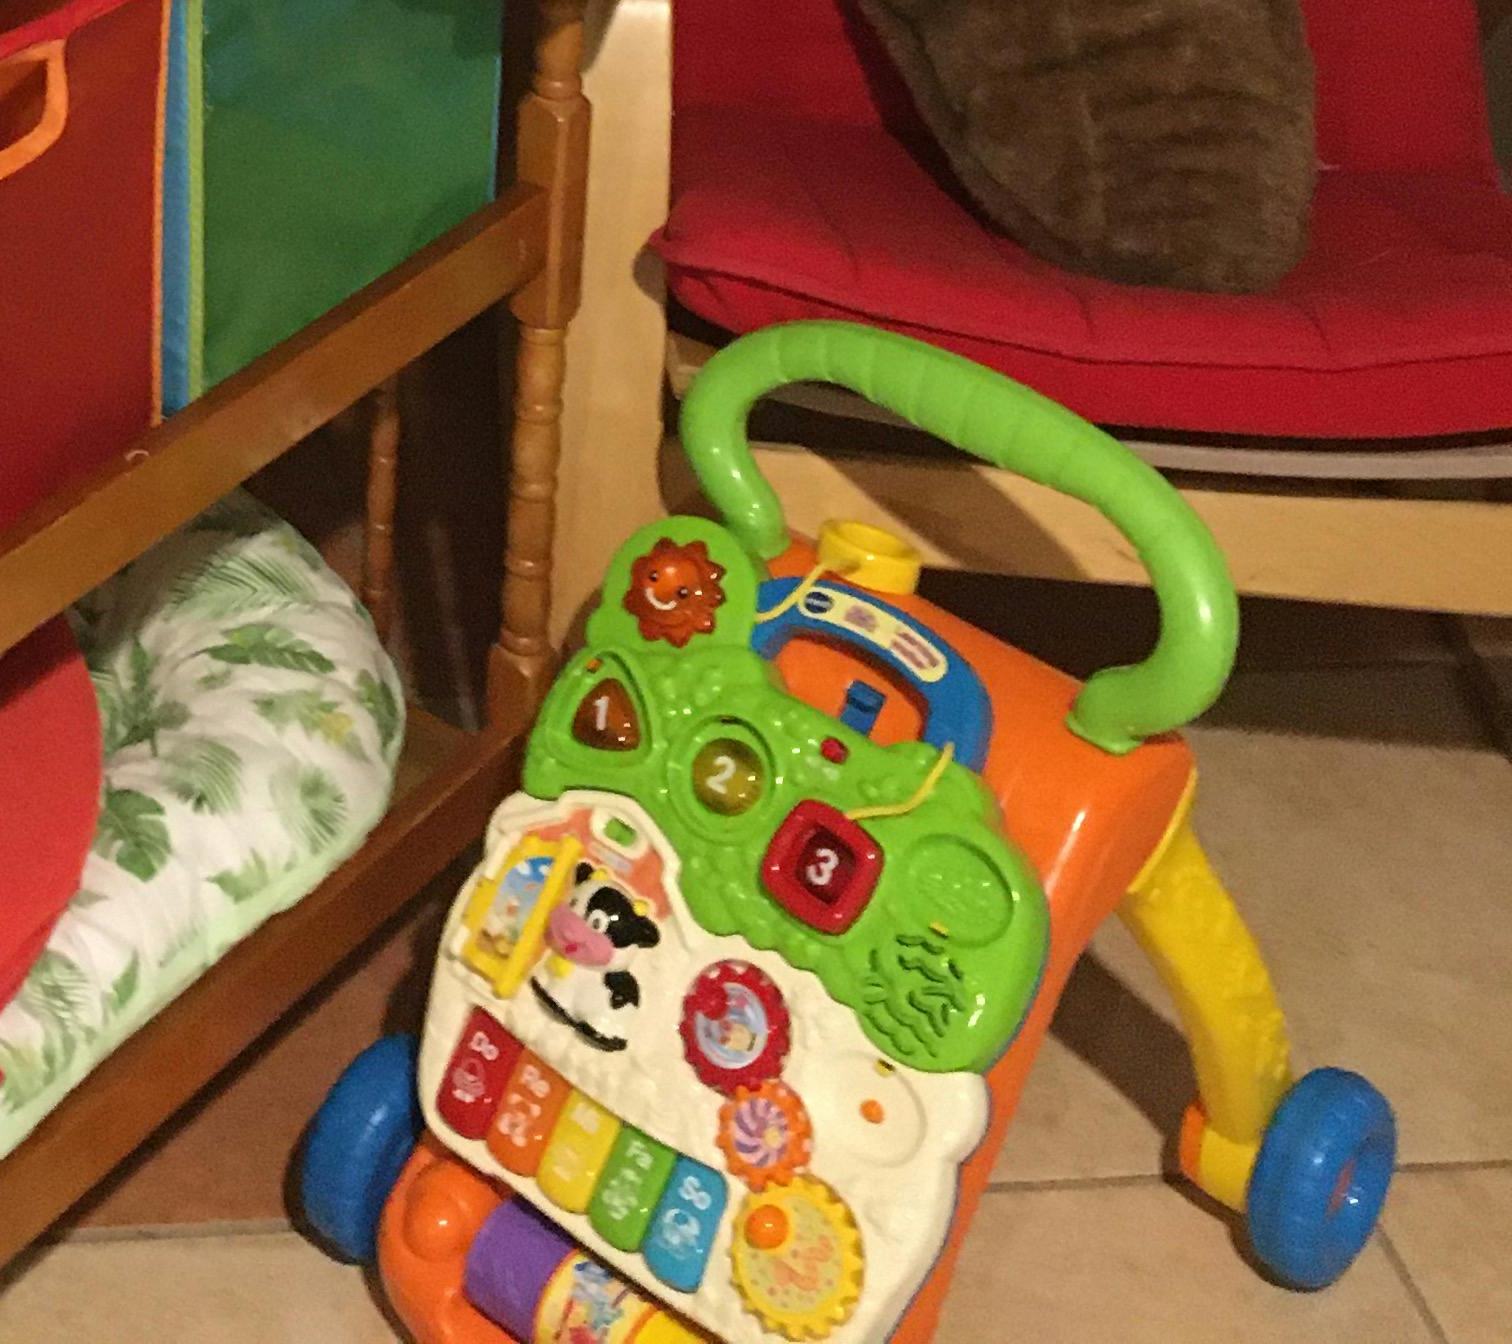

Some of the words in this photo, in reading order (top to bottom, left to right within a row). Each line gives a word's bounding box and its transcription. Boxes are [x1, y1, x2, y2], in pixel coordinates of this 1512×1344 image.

[592, 696, 610, 731] 1
[706, 755, 736, 795] 2
[806, 848, 838, 886] 3
[678, 1175, 713, 1210] So
